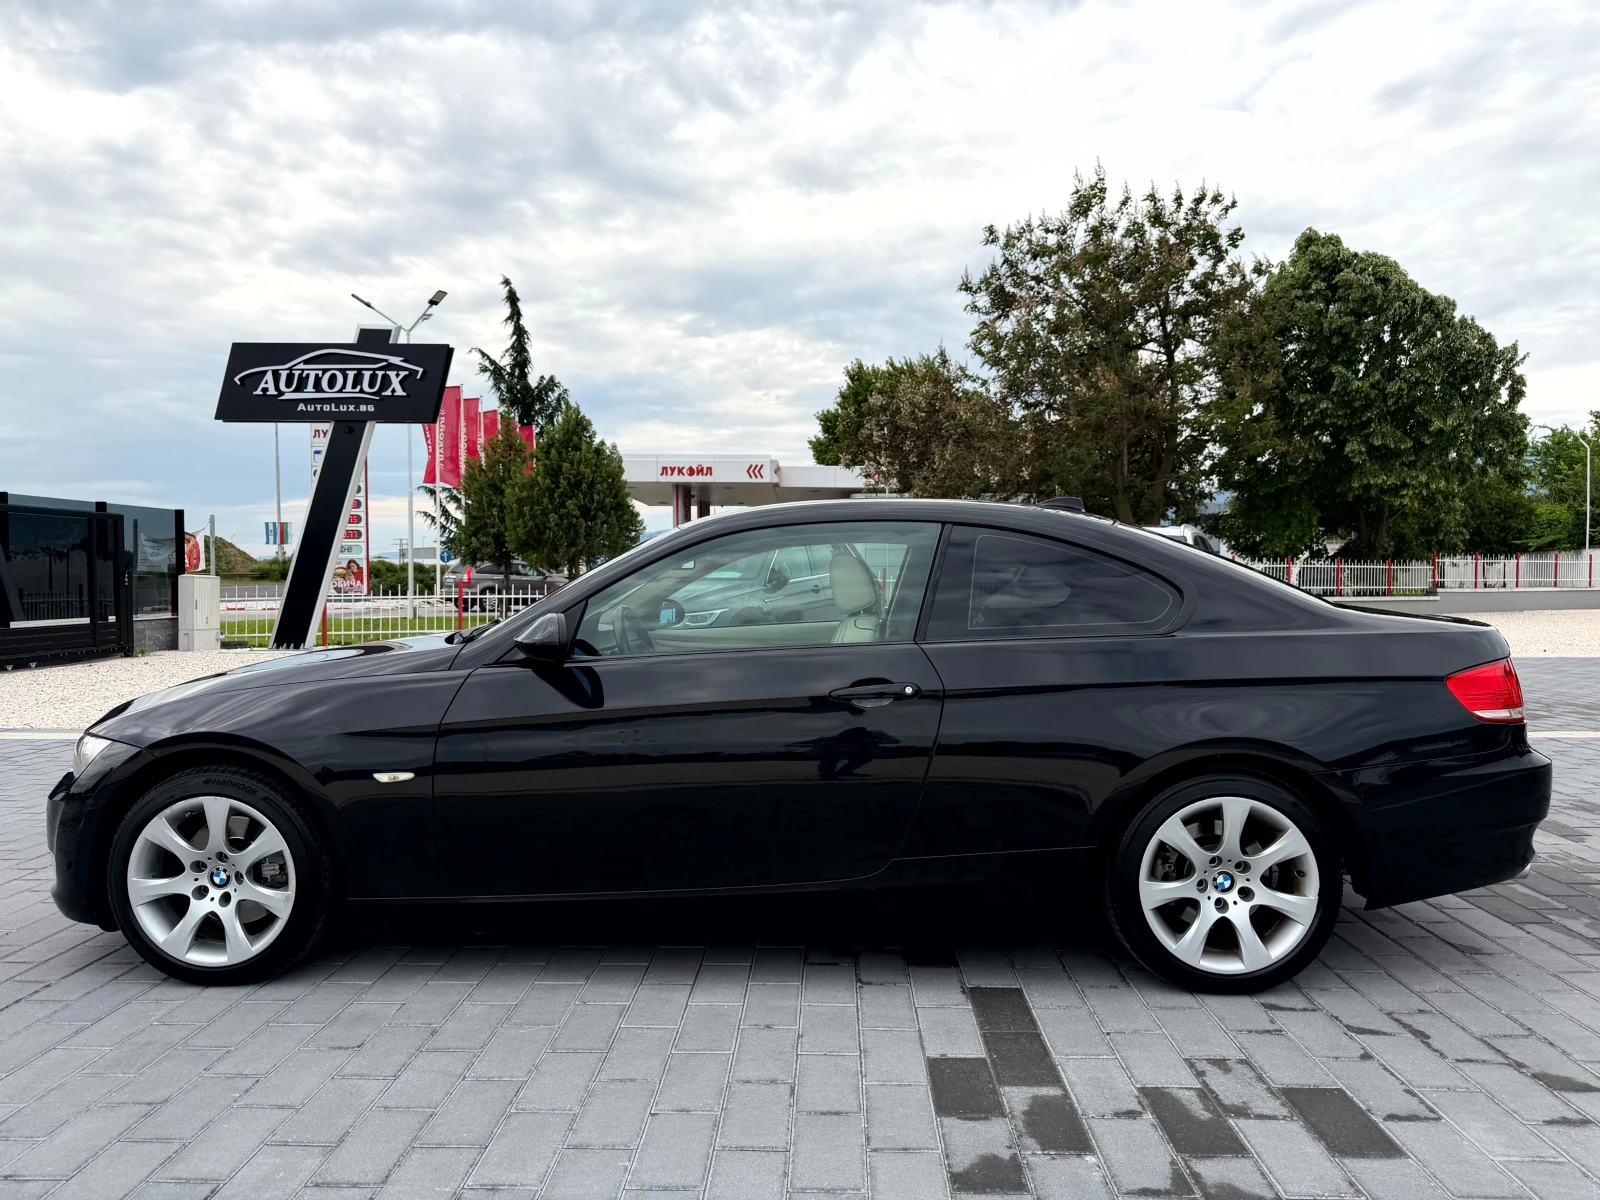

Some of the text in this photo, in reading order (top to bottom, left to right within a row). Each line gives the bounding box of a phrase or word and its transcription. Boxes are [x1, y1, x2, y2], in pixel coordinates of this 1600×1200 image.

[253, 369, 409, 396] AUTOLUX
[312, 429, 328, 438] ЛУ
[660, 464, 712, 476] ЛУКОЙЛ
